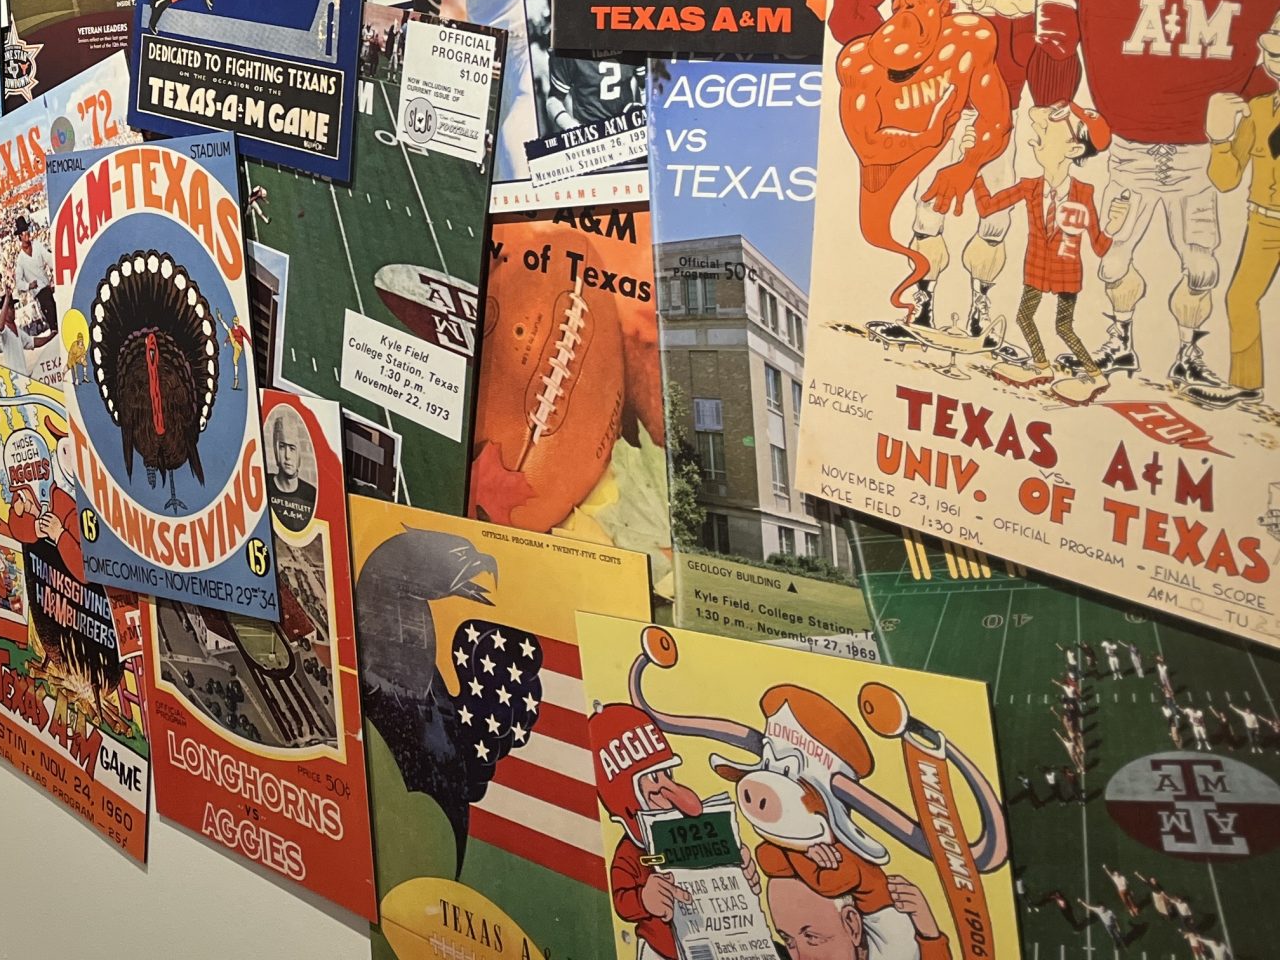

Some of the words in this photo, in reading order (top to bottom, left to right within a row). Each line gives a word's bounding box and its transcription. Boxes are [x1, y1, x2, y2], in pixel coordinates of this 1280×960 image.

[591, 5, 706, 32] TEXAS
[712, 6, 792, 33] A&M
[431, 45, 491, 68] PROGRAM
[439, 30, 491, 52] OFFICIAL
[149, 43, 202, 68] DEDICATED
[225, 57, 283, 84] FIGHTING
[288, 69, 336, 95] TEXANS
[459, 69, 489, 85] $1.00
[663, 72, 822, 109] AGGIES
[894, 70, 953, 110] JINX
[268, 104, 330, 143] GAME
[561, 124, 598, 148] TEXAS
[666, 165, 817, 201] TEXAS
[565, 251, 651, 303] Texas
[349, 337, 383, 360] College
[429, 372, 459, 394] Texas
[380, 335, 402, 352] Kyle
[405, 345, 429, 363] Field
[355, 370, 403, 399] November
[426, 402, 450, 421] 1973
[12, 436, 34, 451] THOSE
[896, 385, 1058, 469] TEXAS
[9, 459, 50, 485] AGGIES
[11, 448, 39, 464] TOUGH
[70, 422, 263, 568] THANKSGIVING
[876, 432, 988, 503] UNIV.
[1019, 477, 1076, 524] OF
[1102, 497, 1271, 583] TEXAS
[482, 530, 510, 542] OFFICIAL
[512, 536, 544, 549] PROGRAM
[599, 554, 622, 565] CENTS
[821, 463, 897, 498] NOVEMBER
[935, 498, 961, 516] 1961
[992, 517, 1051, 547] OFFICIAL
[1059, 537, 1125, 569] PROGRAM
[1153, 565, 1202, 592] FINAL
[1212, 582, 1267, 610] SCORE
[29, 552, 112, 620] THANKSGIVING
[688, 560, 732, 578] GEOLOGY
[736, 571, 781, 590] BUILDING
[757, 622, 819, 647] November
[846, 645, 876, 660] 1969
[598, 723, 666, 783] AGGIE
[767, 719, 836, 771] LONGHORN
[100, 743, 142, 792] GAME
[166, 729, 344, 842] LONGHORNS
[40, 752, 68, 785] NOV.
[101, 795, 133, 832] 1960
[201, 800, 307, 882] AGGIES
[669, 821, 718, 844] 1922
[915, 759, 977, 898] WELCOME
[665, 840, 730, 862] CLIPPINGS
[705, 914, 754, 931] AUSTIN
